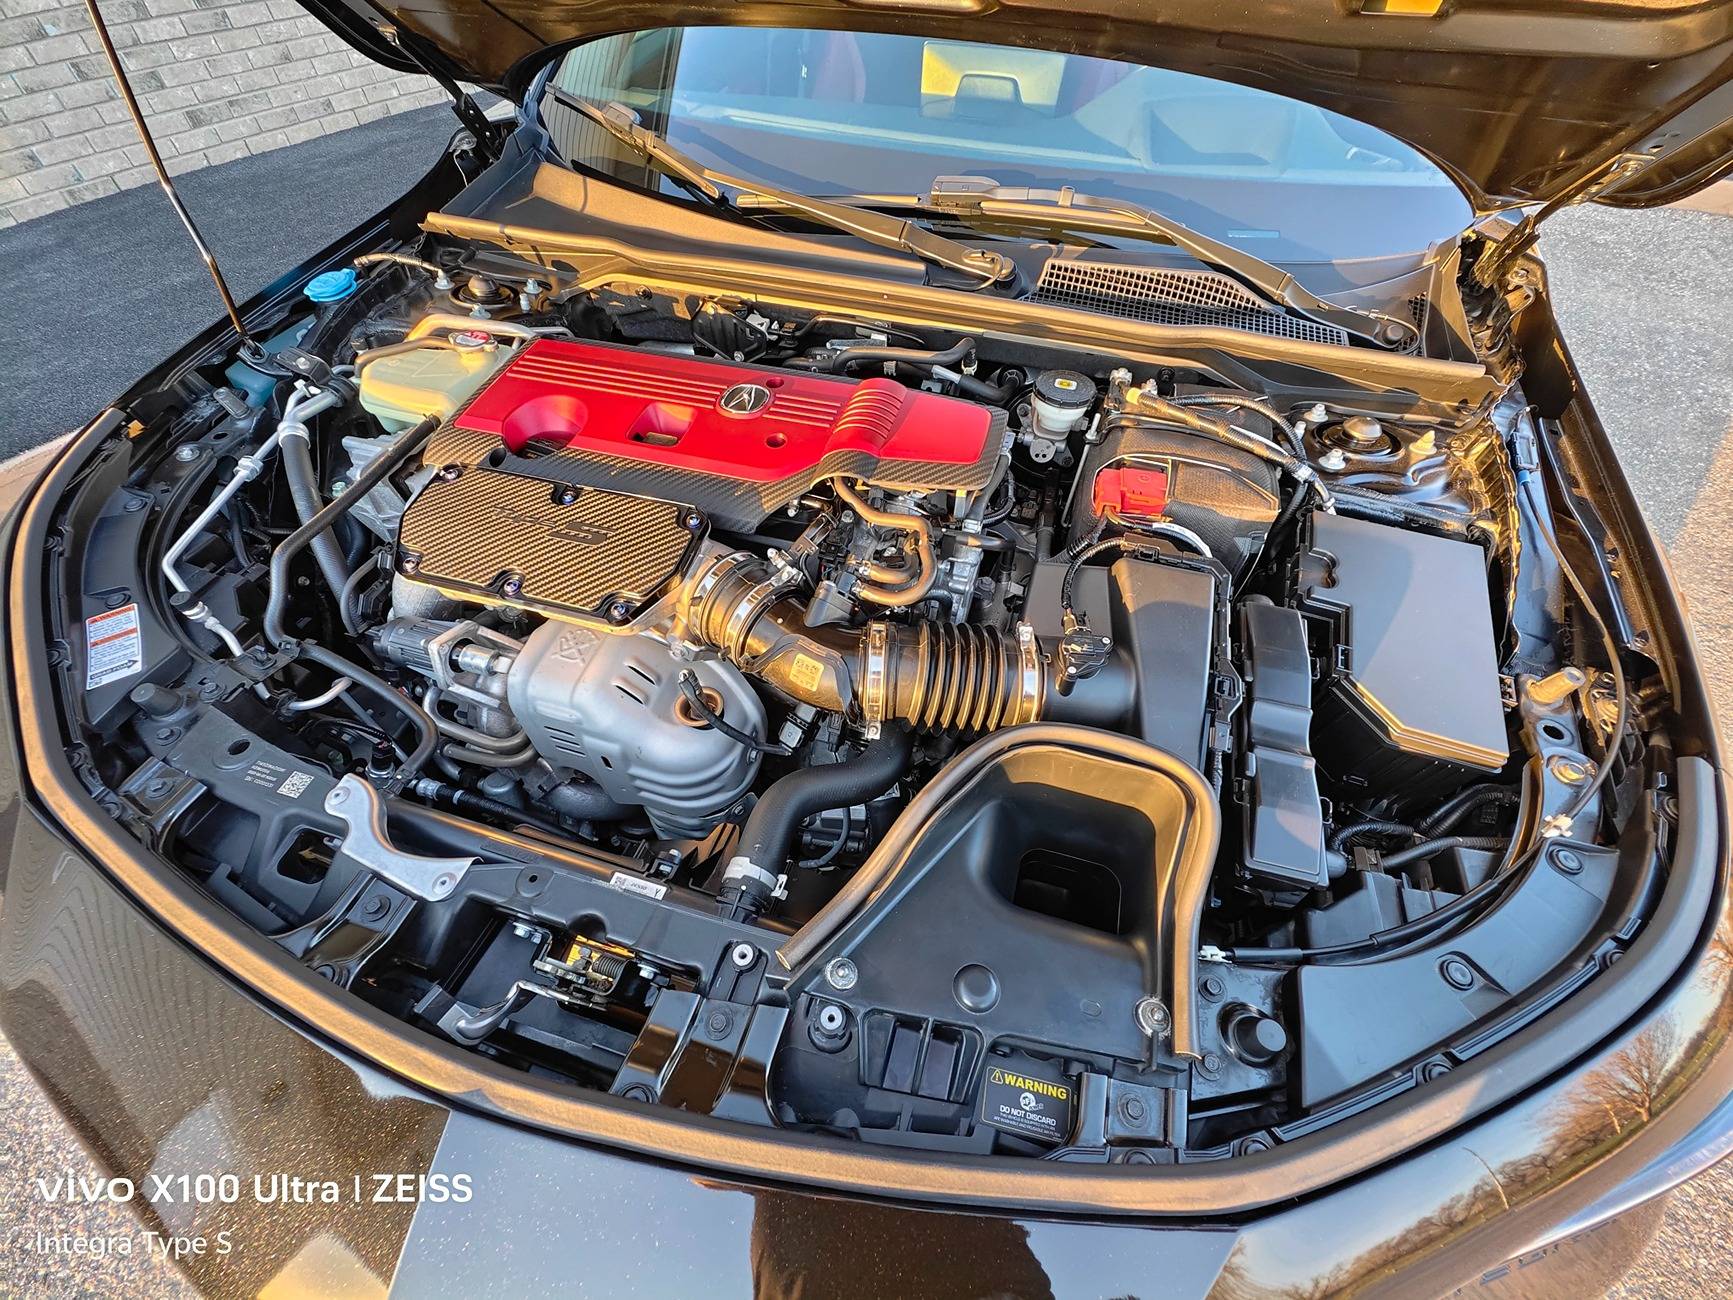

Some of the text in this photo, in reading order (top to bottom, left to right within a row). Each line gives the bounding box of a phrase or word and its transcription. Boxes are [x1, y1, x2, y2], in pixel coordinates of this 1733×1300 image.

[1004, 1073, 1067, 1100] WARNING
[1000, 1105, 1056, 1126] DO NOT DISCARD
